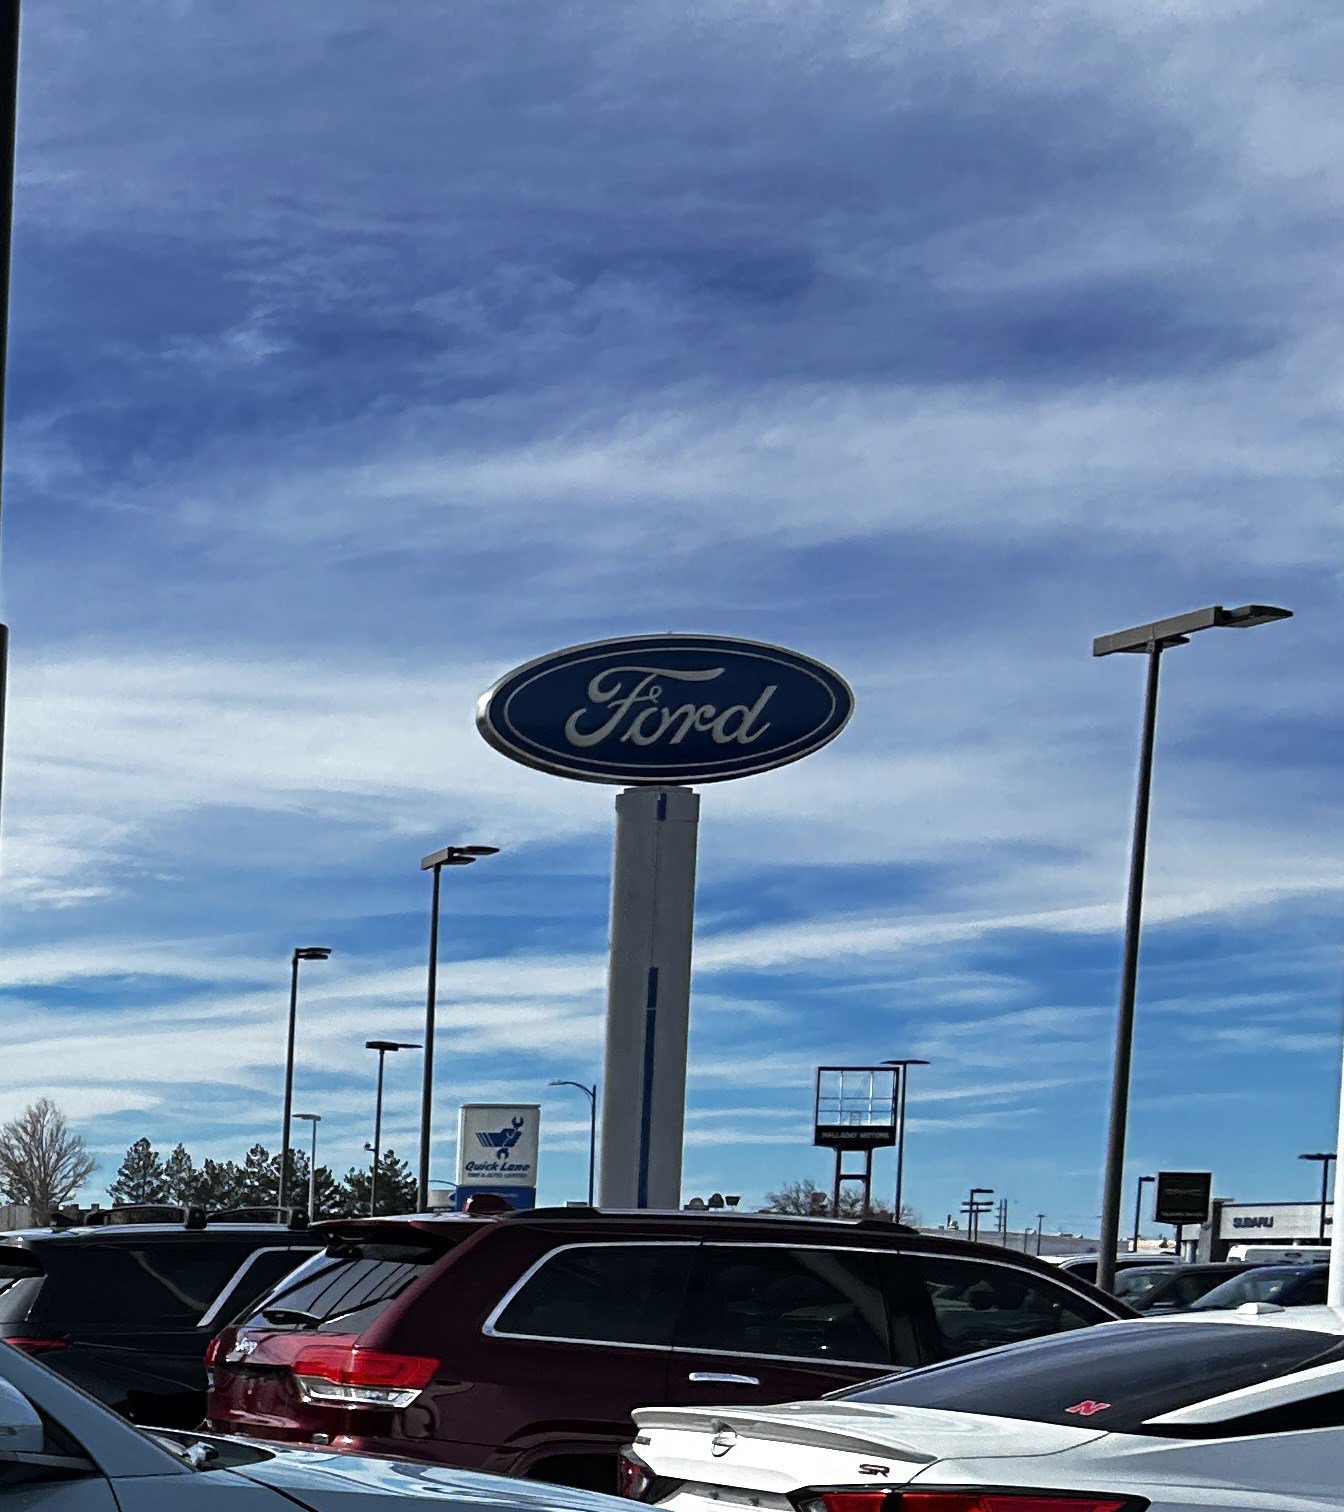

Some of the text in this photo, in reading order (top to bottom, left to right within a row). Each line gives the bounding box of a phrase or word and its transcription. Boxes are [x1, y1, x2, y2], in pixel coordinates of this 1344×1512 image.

[565, 666, 778, 748] Ford
[465, 1160, 530, 1171] Quick Lane
[1233, 1216, 1274, 1228] SUBARU
[858, 1464, 890, 1478] SR
